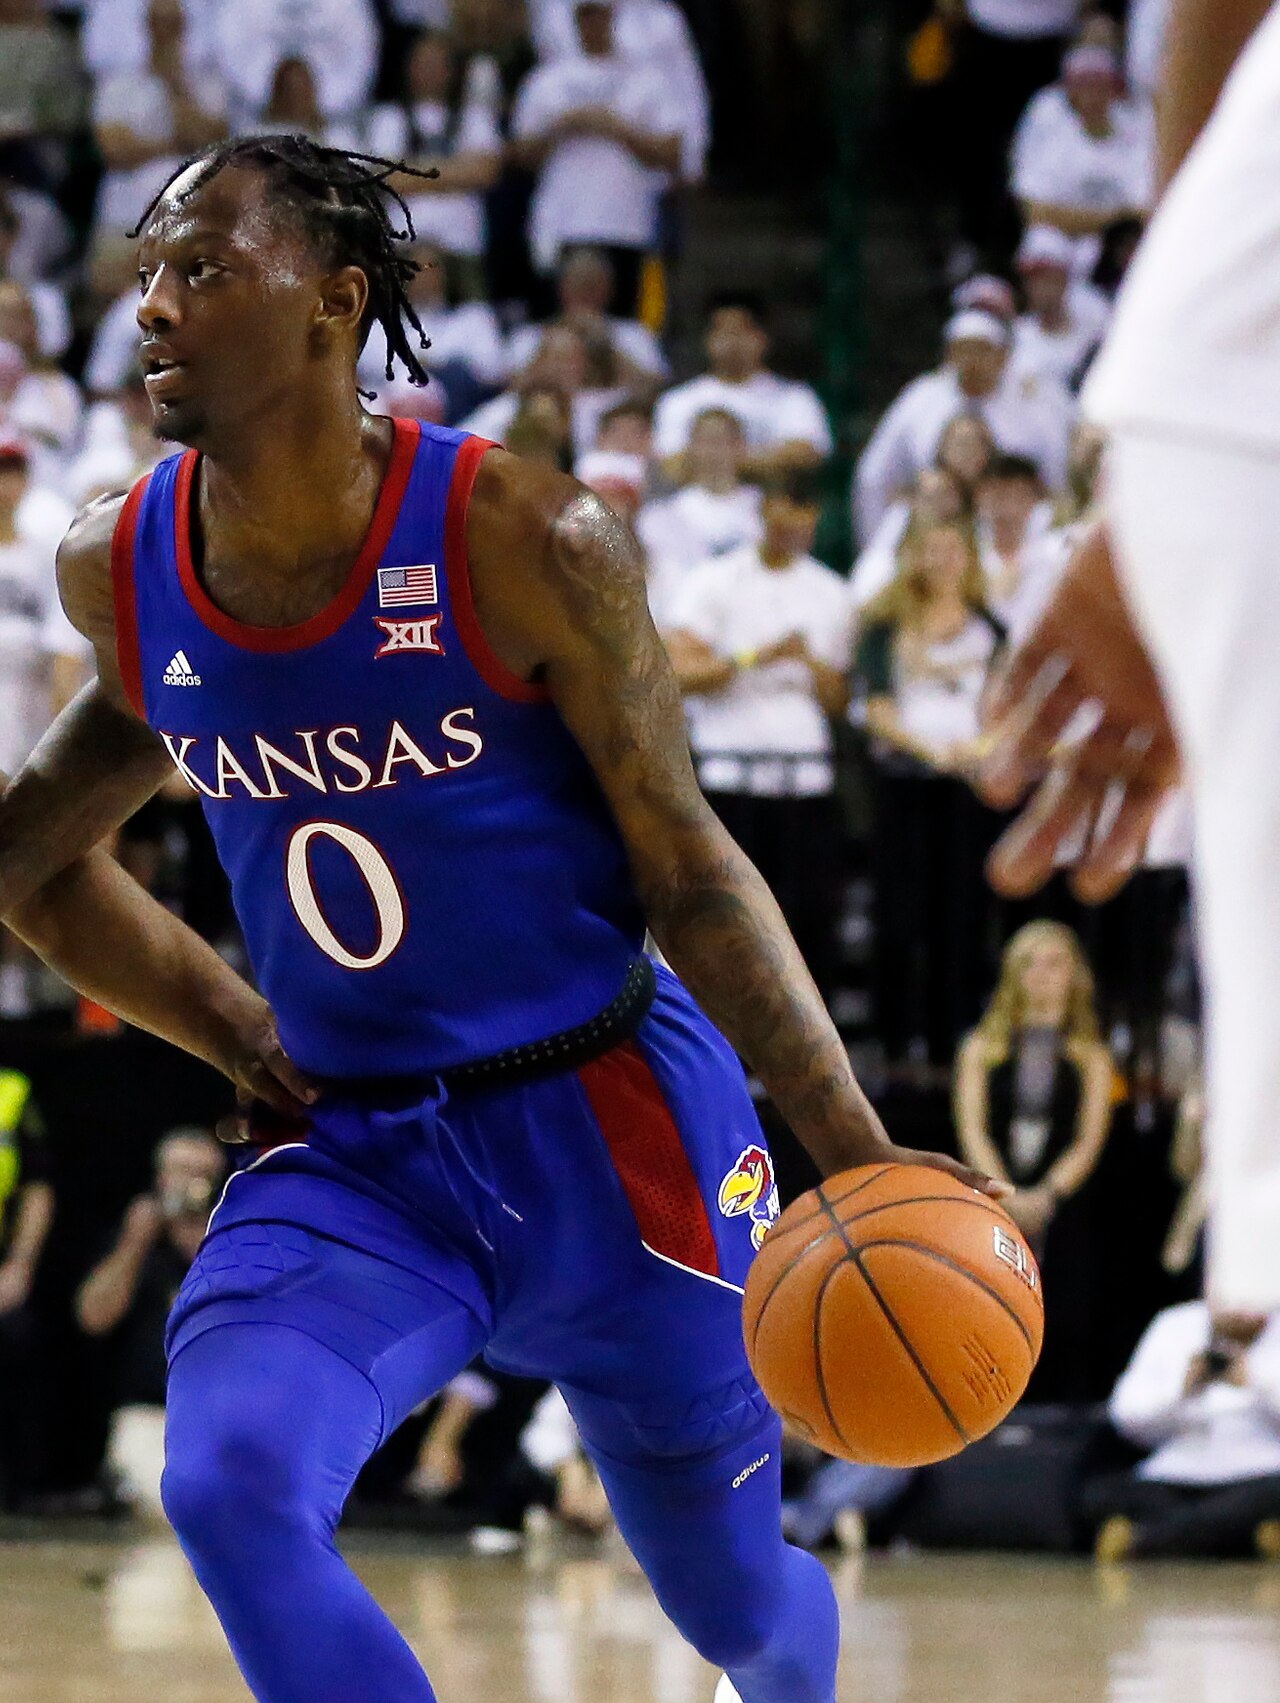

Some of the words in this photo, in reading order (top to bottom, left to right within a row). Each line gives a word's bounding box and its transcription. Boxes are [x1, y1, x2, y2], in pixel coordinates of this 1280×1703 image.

[162, 673, 202, 687] adidas
[158, 707, 484, 800] KANSAS
[286, 819, 406, 970] 0
